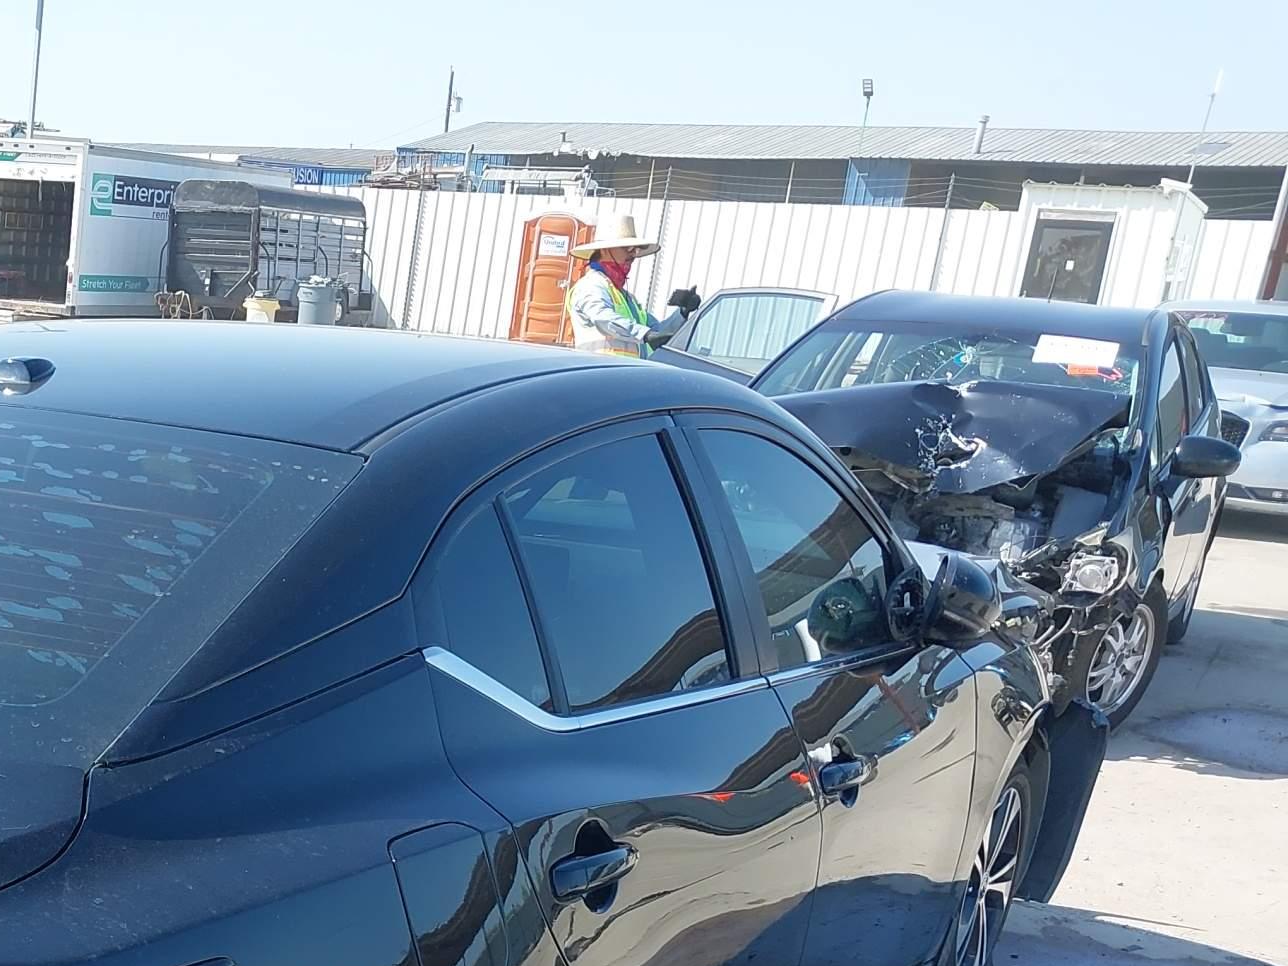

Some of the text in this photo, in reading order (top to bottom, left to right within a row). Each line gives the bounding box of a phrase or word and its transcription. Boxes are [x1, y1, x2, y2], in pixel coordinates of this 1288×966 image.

[114, 181, 176, 208] Enterpri
[82, 279, 107, 289] Stretch
[108, 279, 124, 289] Your
